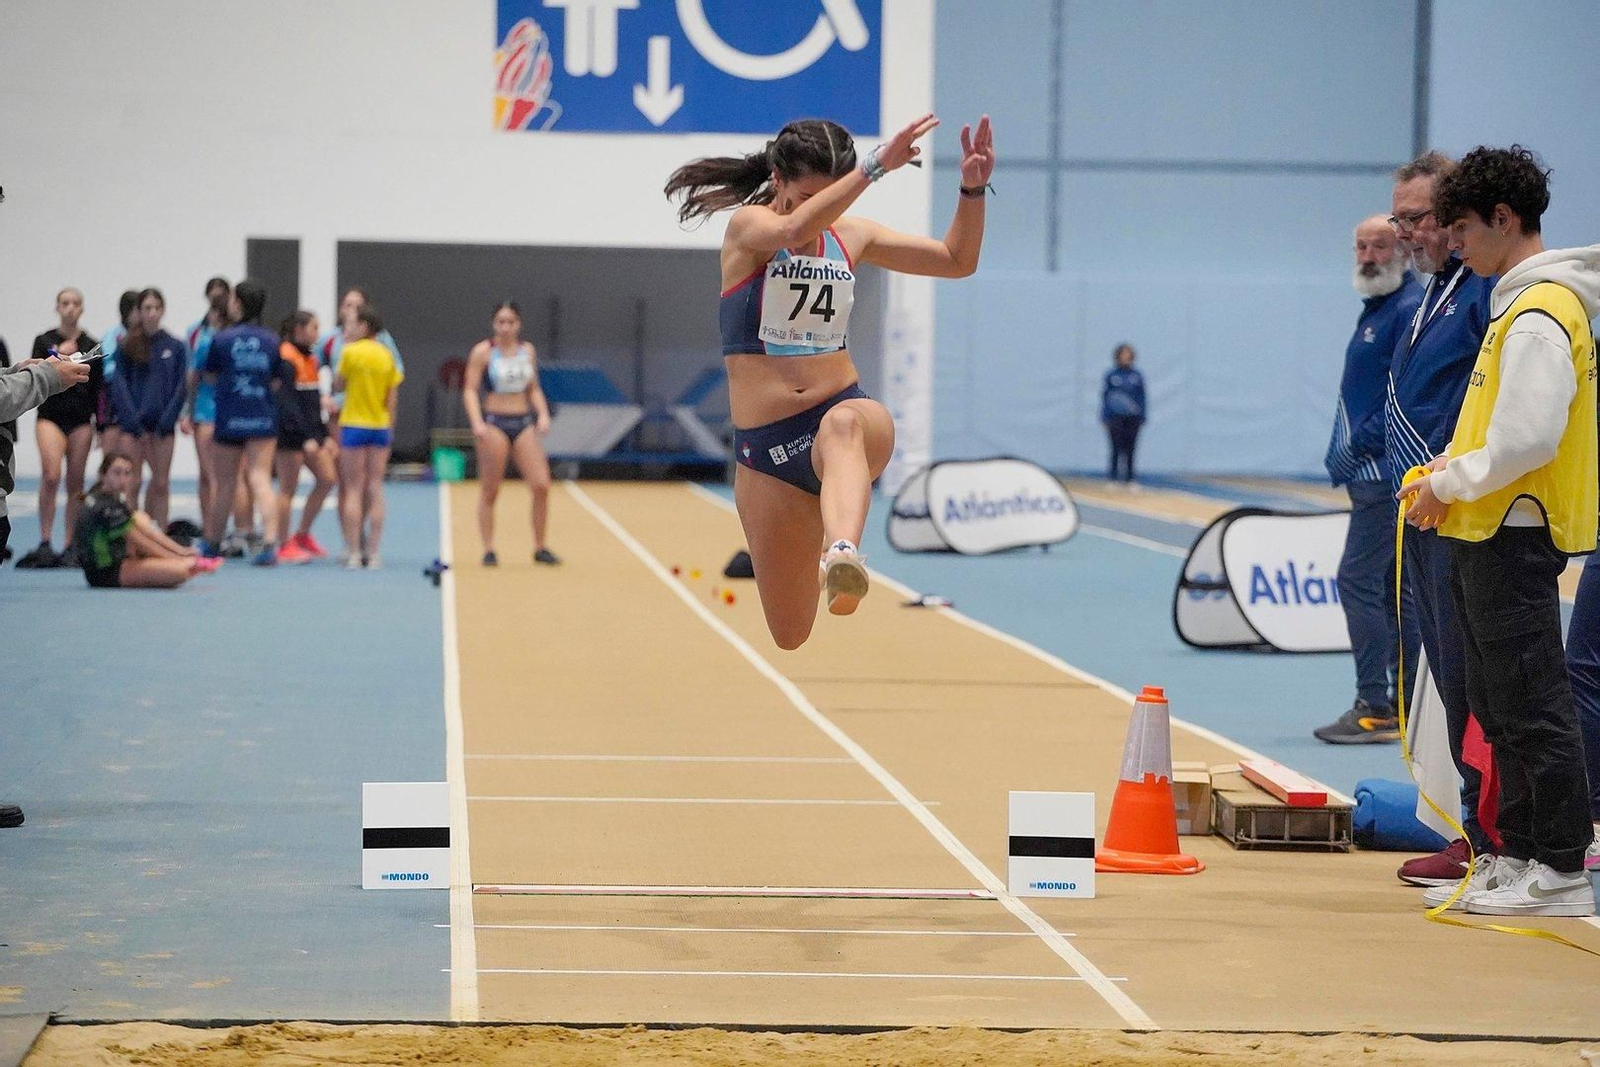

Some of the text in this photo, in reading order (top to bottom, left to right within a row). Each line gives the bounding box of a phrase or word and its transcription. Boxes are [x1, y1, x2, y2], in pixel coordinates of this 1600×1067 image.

[770, 259, 853, 281] Atlántico
[788, 283, 836, 323] 74
[944, 489, 1064, 522] Atlántico
[389, 873, 429, 881] MONDO
[1037, 882, 1076, 890] MONDO
